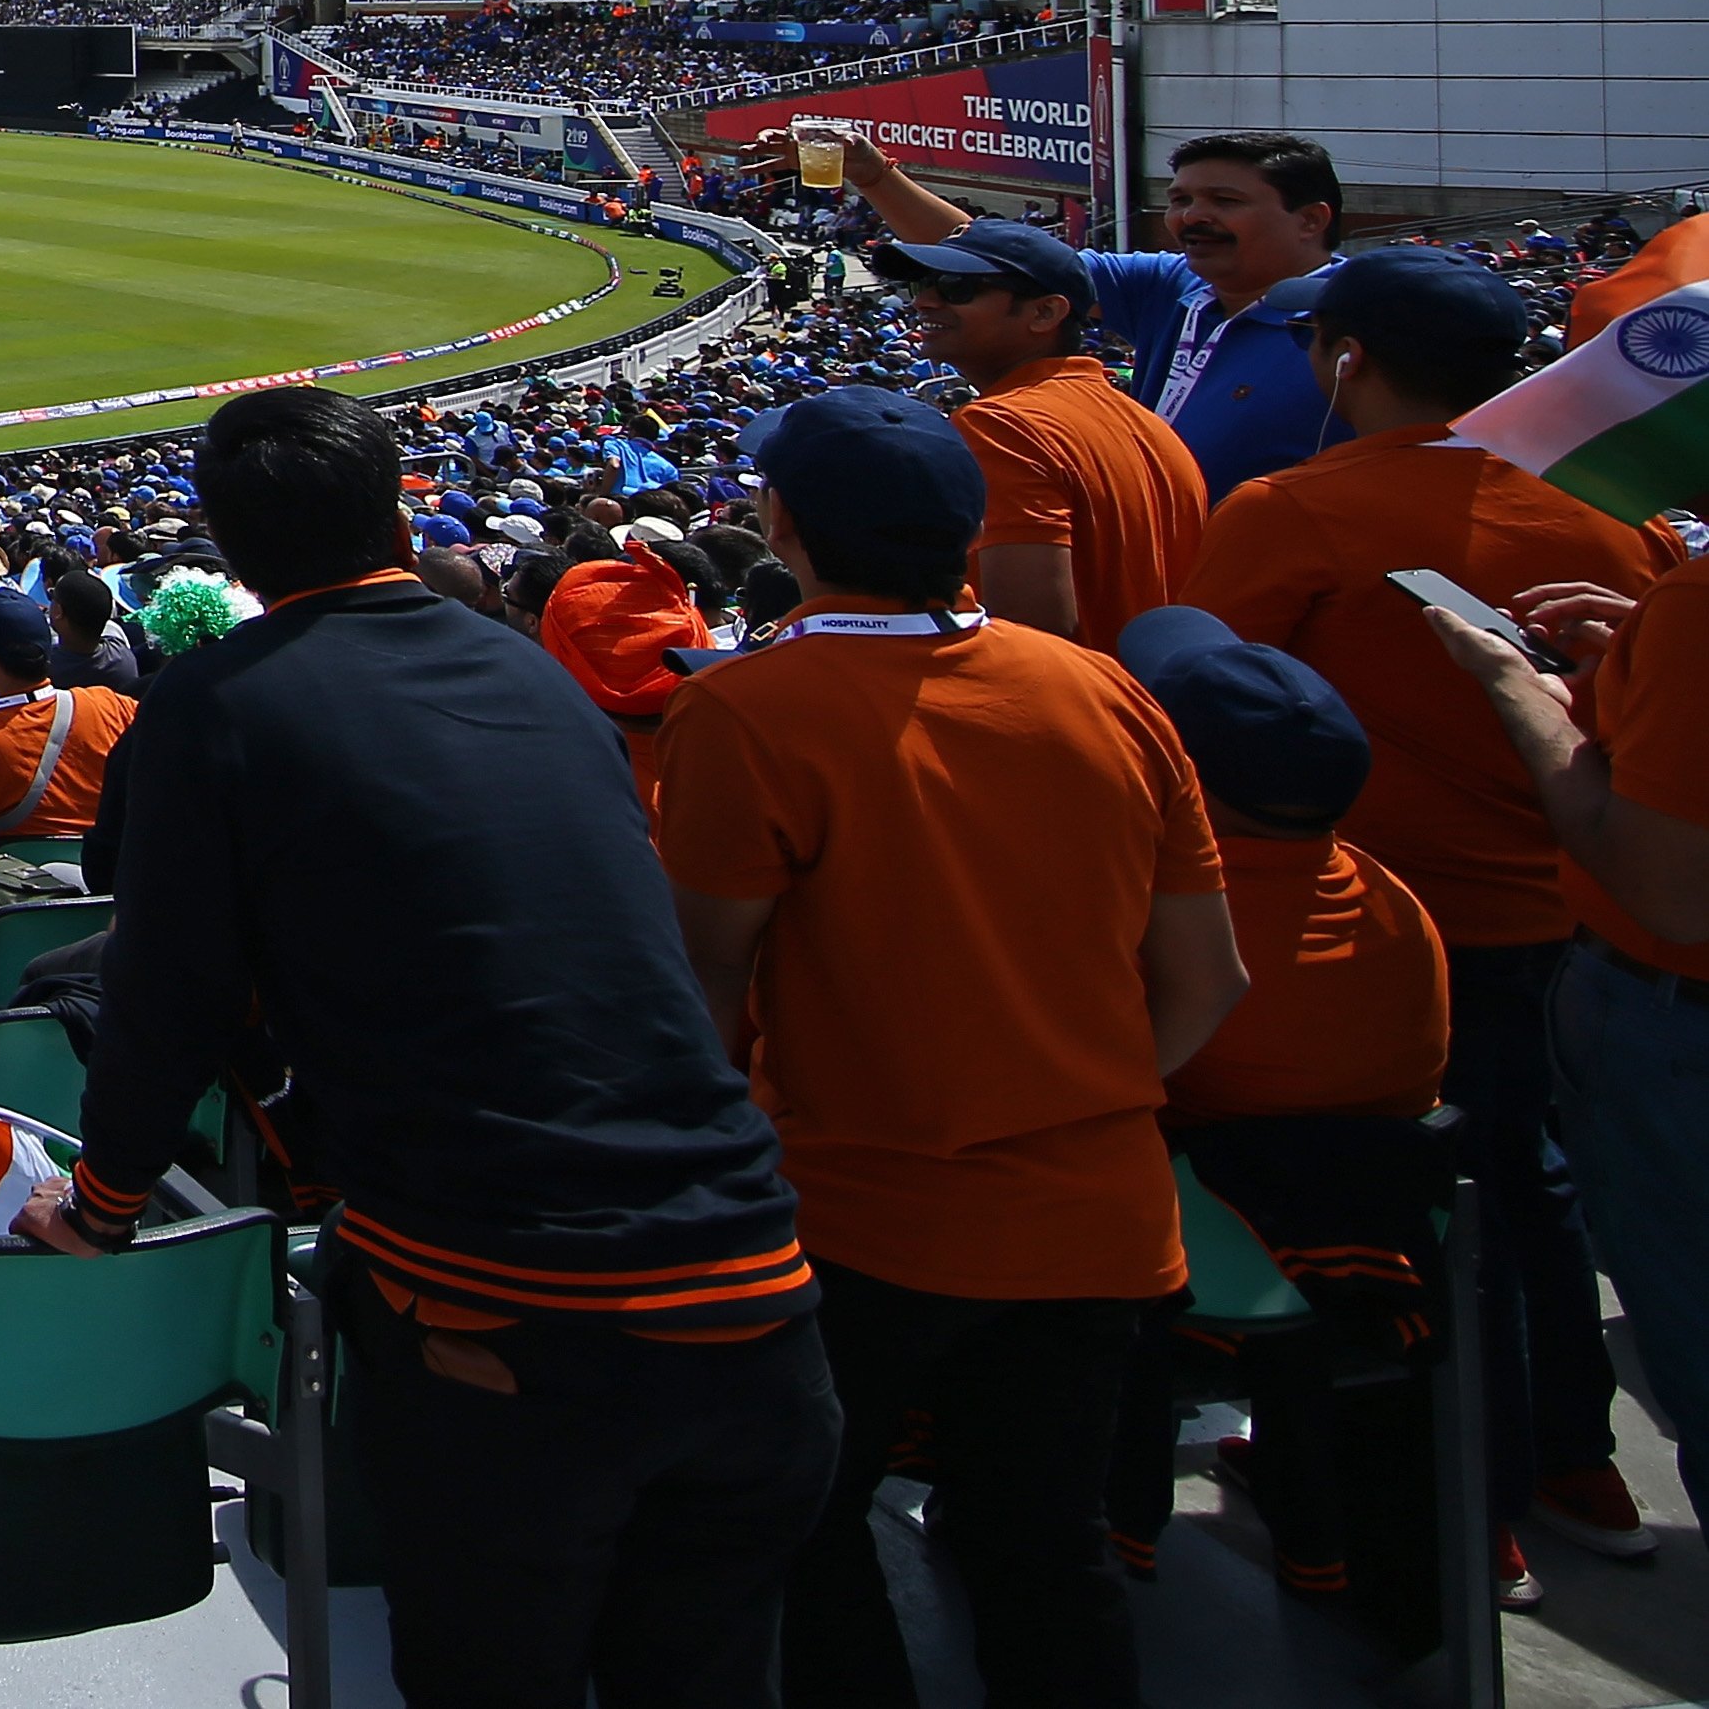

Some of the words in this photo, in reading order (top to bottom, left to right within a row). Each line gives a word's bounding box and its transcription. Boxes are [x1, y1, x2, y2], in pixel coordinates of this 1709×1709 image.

[963, 95, 1003, 120] THE
[165, 129, 215, 141] Booking.com
[878, 122, 957, 150] CRICKET
[962, 131, 1091, 165] CELEBRATIO
[482, 184, 524, 204] Booking.com
[539, 196, 578, 216] Booking.com
[821, 620, 888, 628] HOSPITALITY
